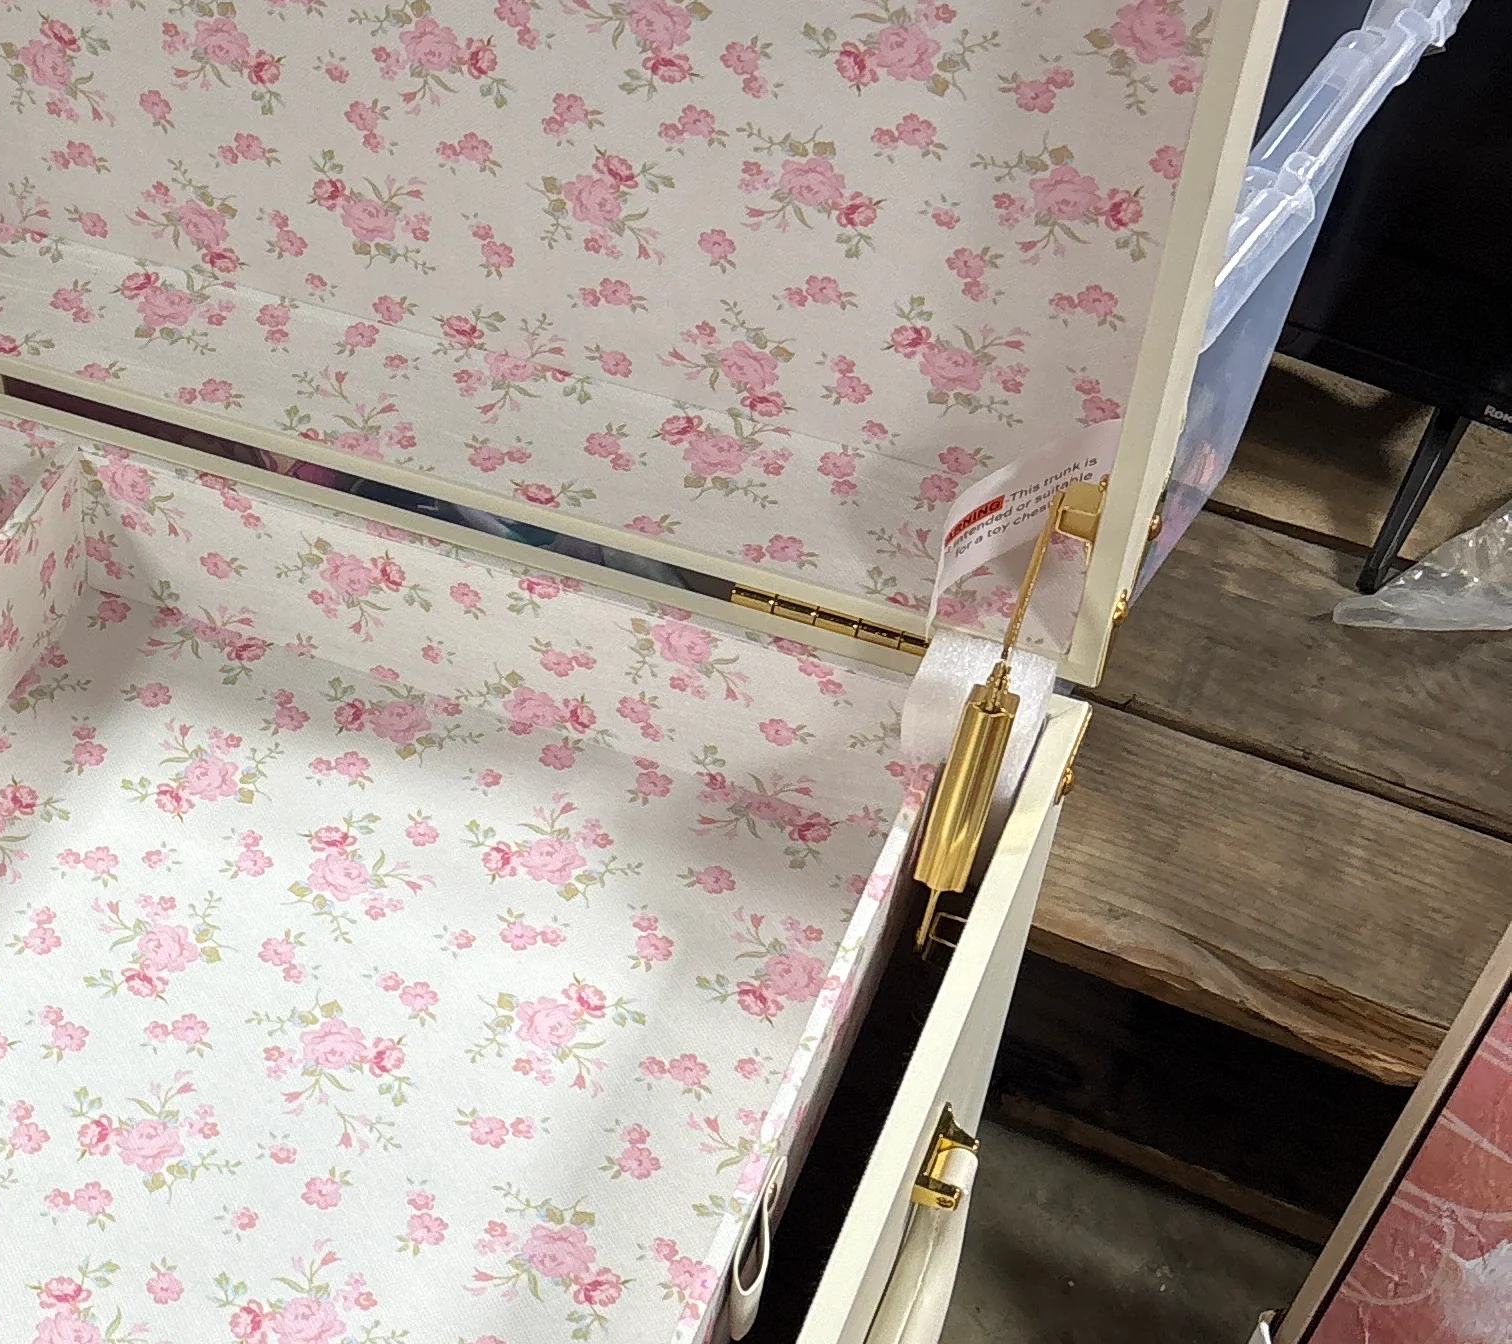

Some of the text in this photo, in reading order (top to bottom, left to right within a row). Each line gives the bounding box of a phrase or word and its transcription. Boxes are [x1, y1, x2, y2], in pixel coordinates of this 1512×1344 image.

[1043, 462, 1080, 487] trunk
[1084, 457, 1098, 468] is
[953, 506, 1013, 548] intended
[1016, 500, 1032, 512] or
[955, 541, 973, 558] for
[974, 536, 984, 545] a
[988, 522, 1010, 538] toy
